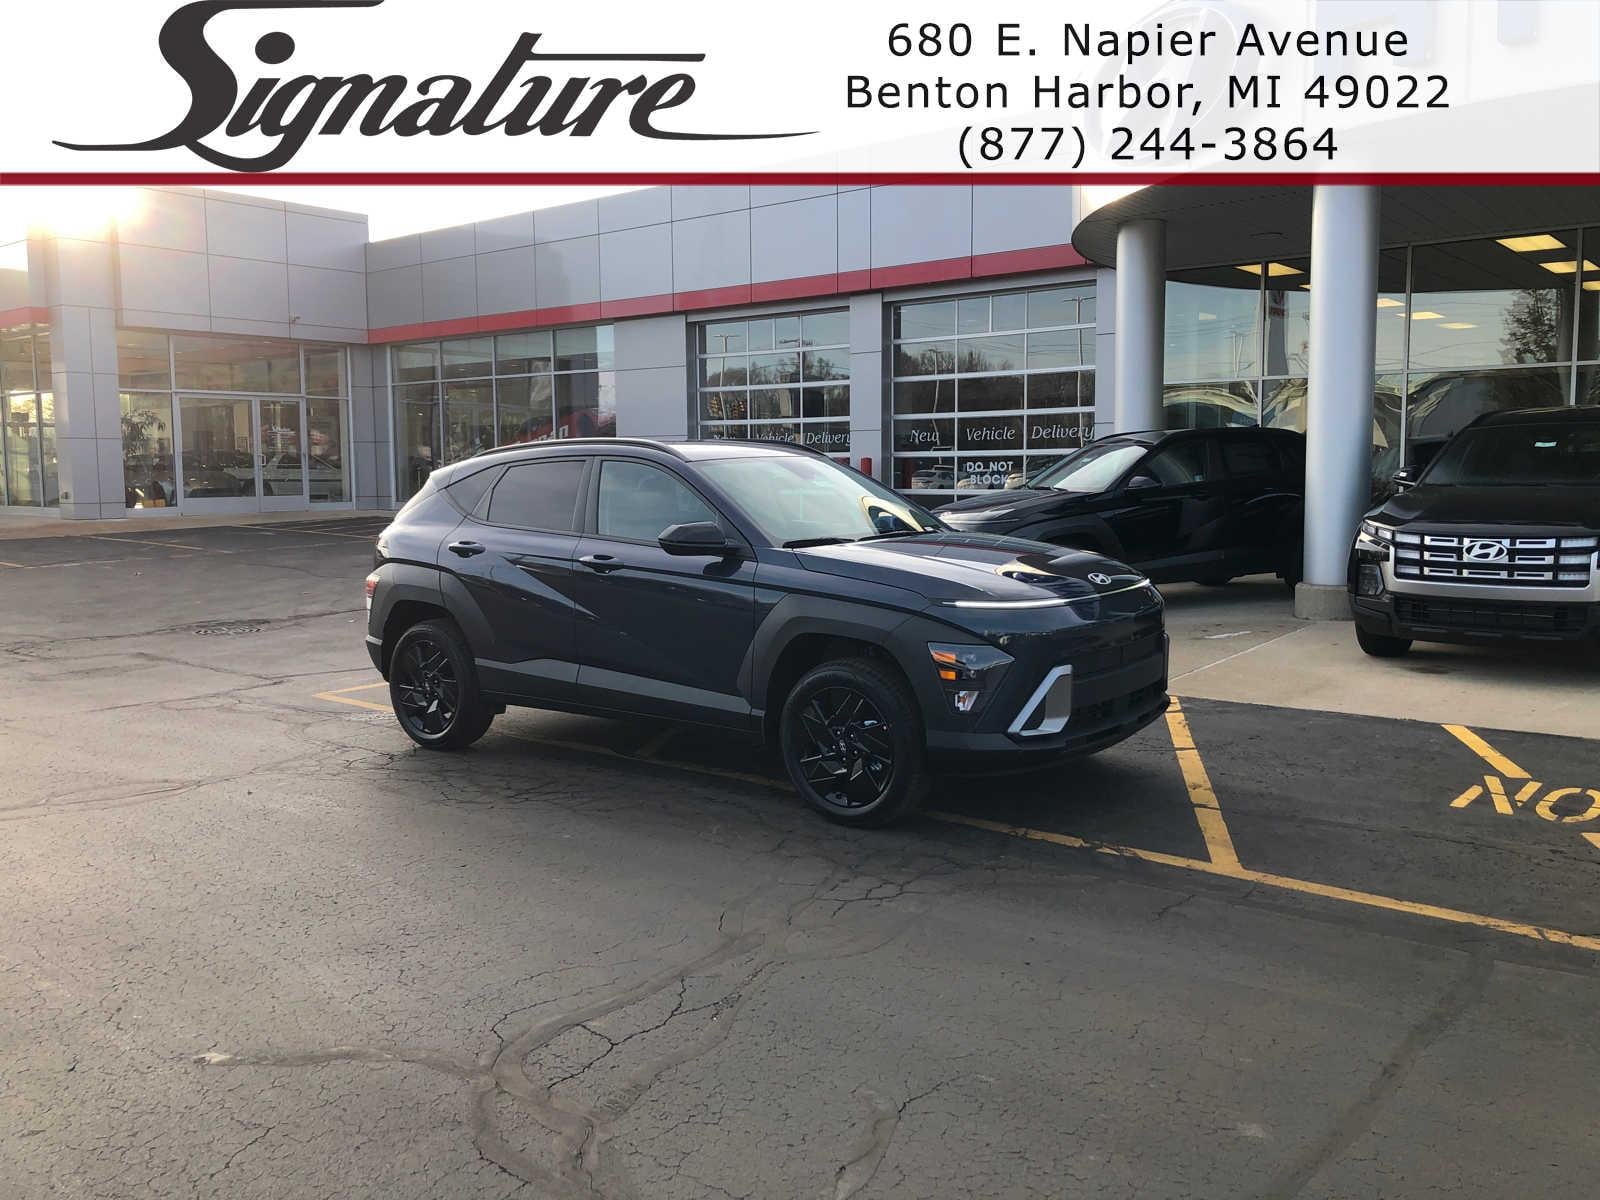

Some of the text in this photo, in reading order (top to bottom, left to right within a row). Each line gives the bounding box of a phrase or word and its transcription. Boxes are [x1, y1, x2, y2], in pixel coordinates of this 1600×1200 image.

[910, 424, 1095, 444] New Vehicle Delivery
[966, 461, 1014, 472] DO NOT
[970, 474, 1008, 485] BLOCK
